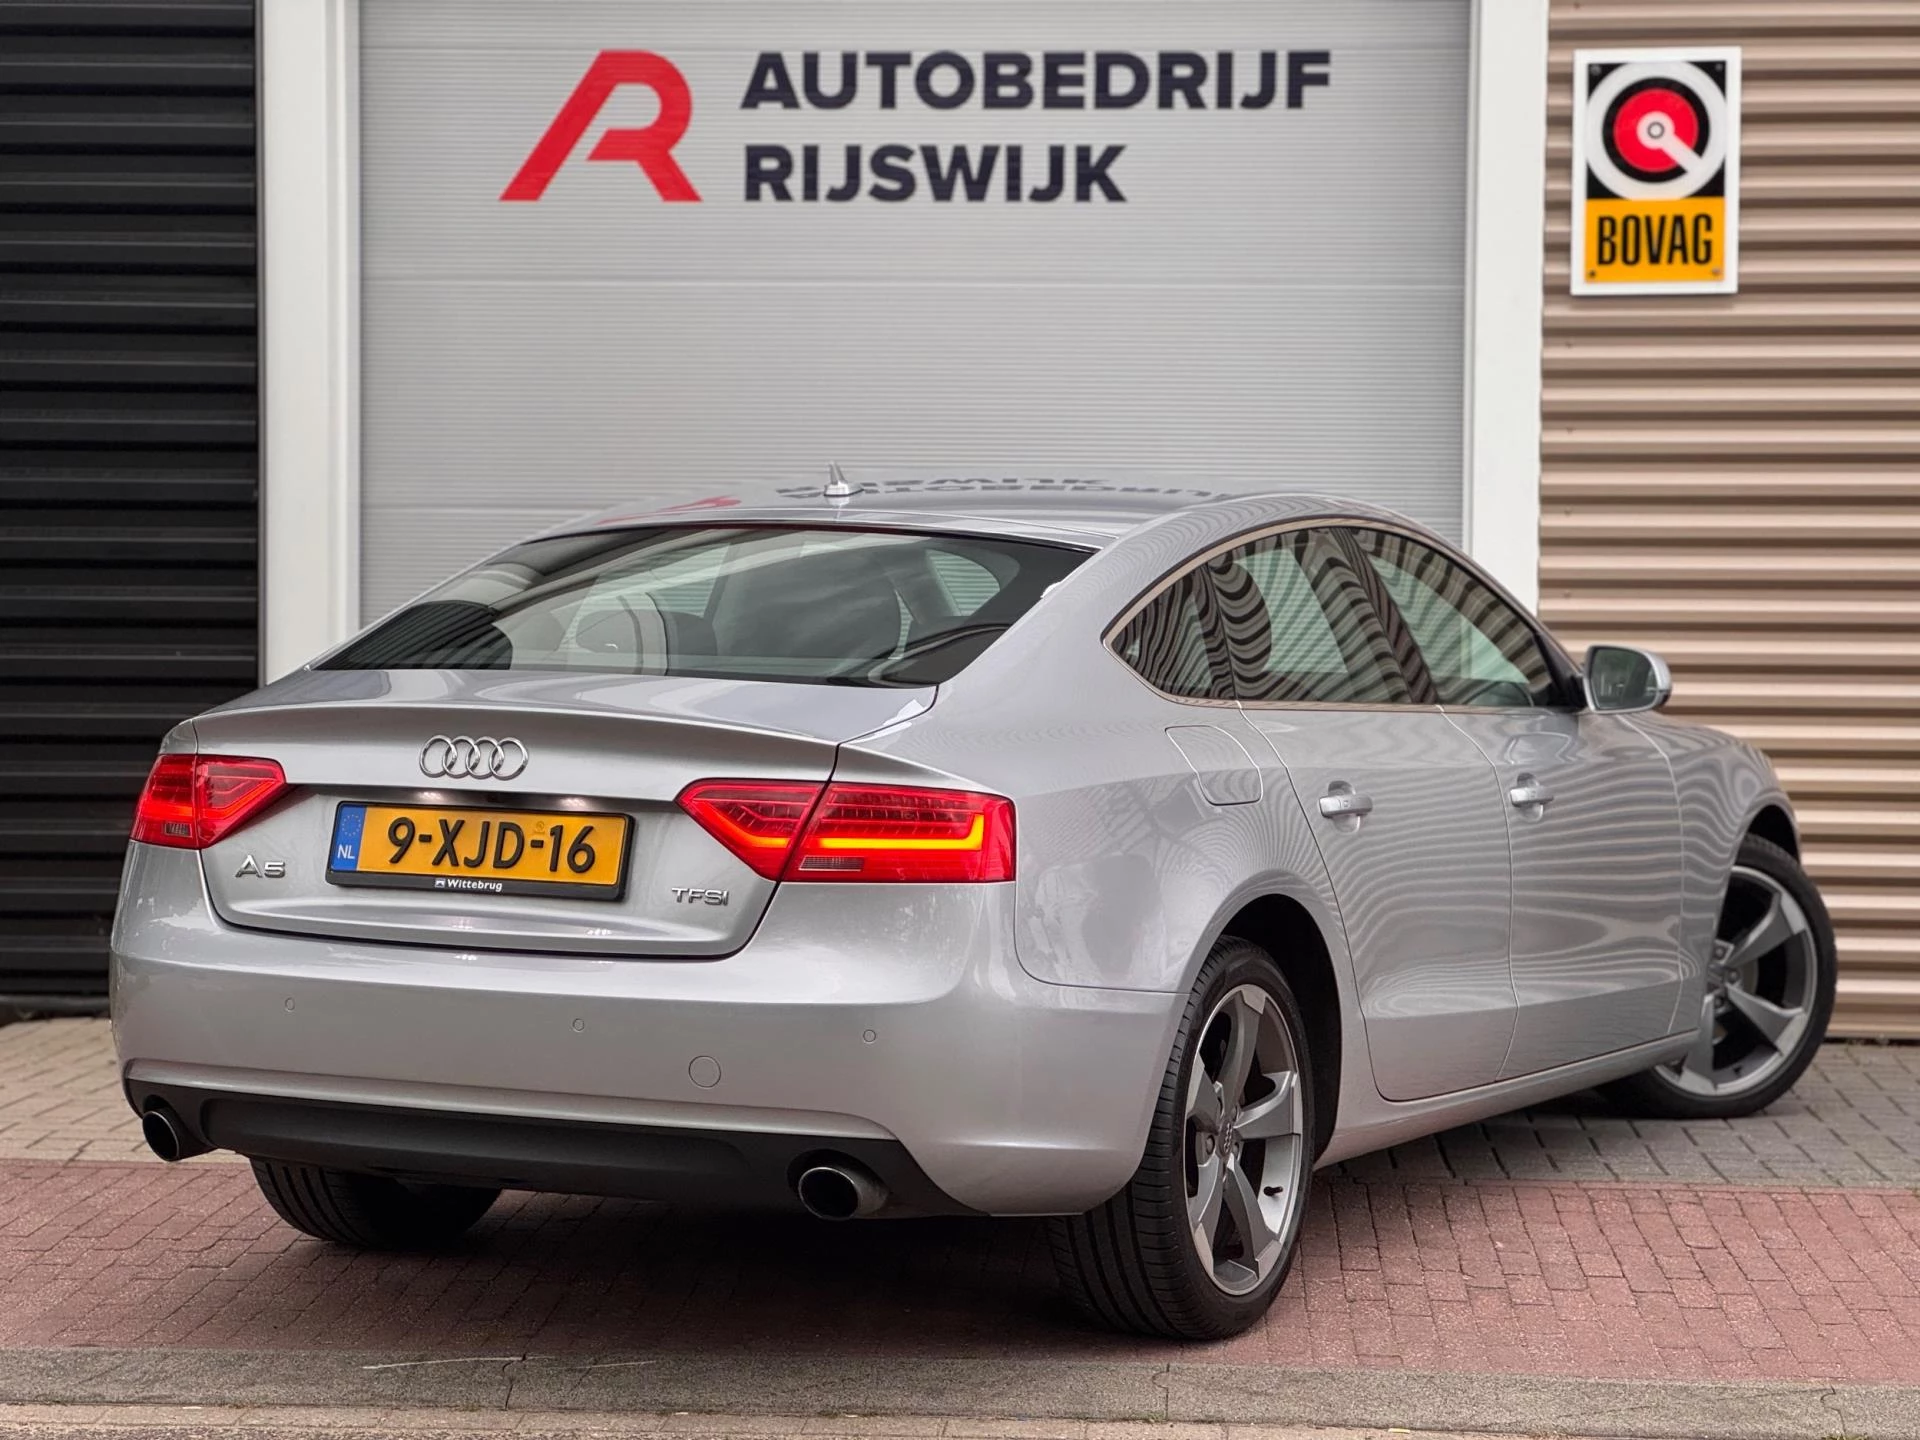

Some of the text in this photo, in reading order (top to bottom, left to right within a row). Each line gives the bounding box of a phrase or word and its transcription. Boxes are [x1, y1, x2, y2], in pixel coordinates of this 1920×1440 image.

[740, 50, 1331, 110] AUTOBEDRIJF
[744, 144, 1127, 203] RIJSWIJK
[1596, 213, 1713, 267] BOVAG
[337, 844, 356, 861] NL
[387, 816, 597, 875] 9-XJD-16
[234, 854, 287, 880] A5
[447, 878, 503, 893] Wittebrug
[671, 887, 729, 907] TFSI
